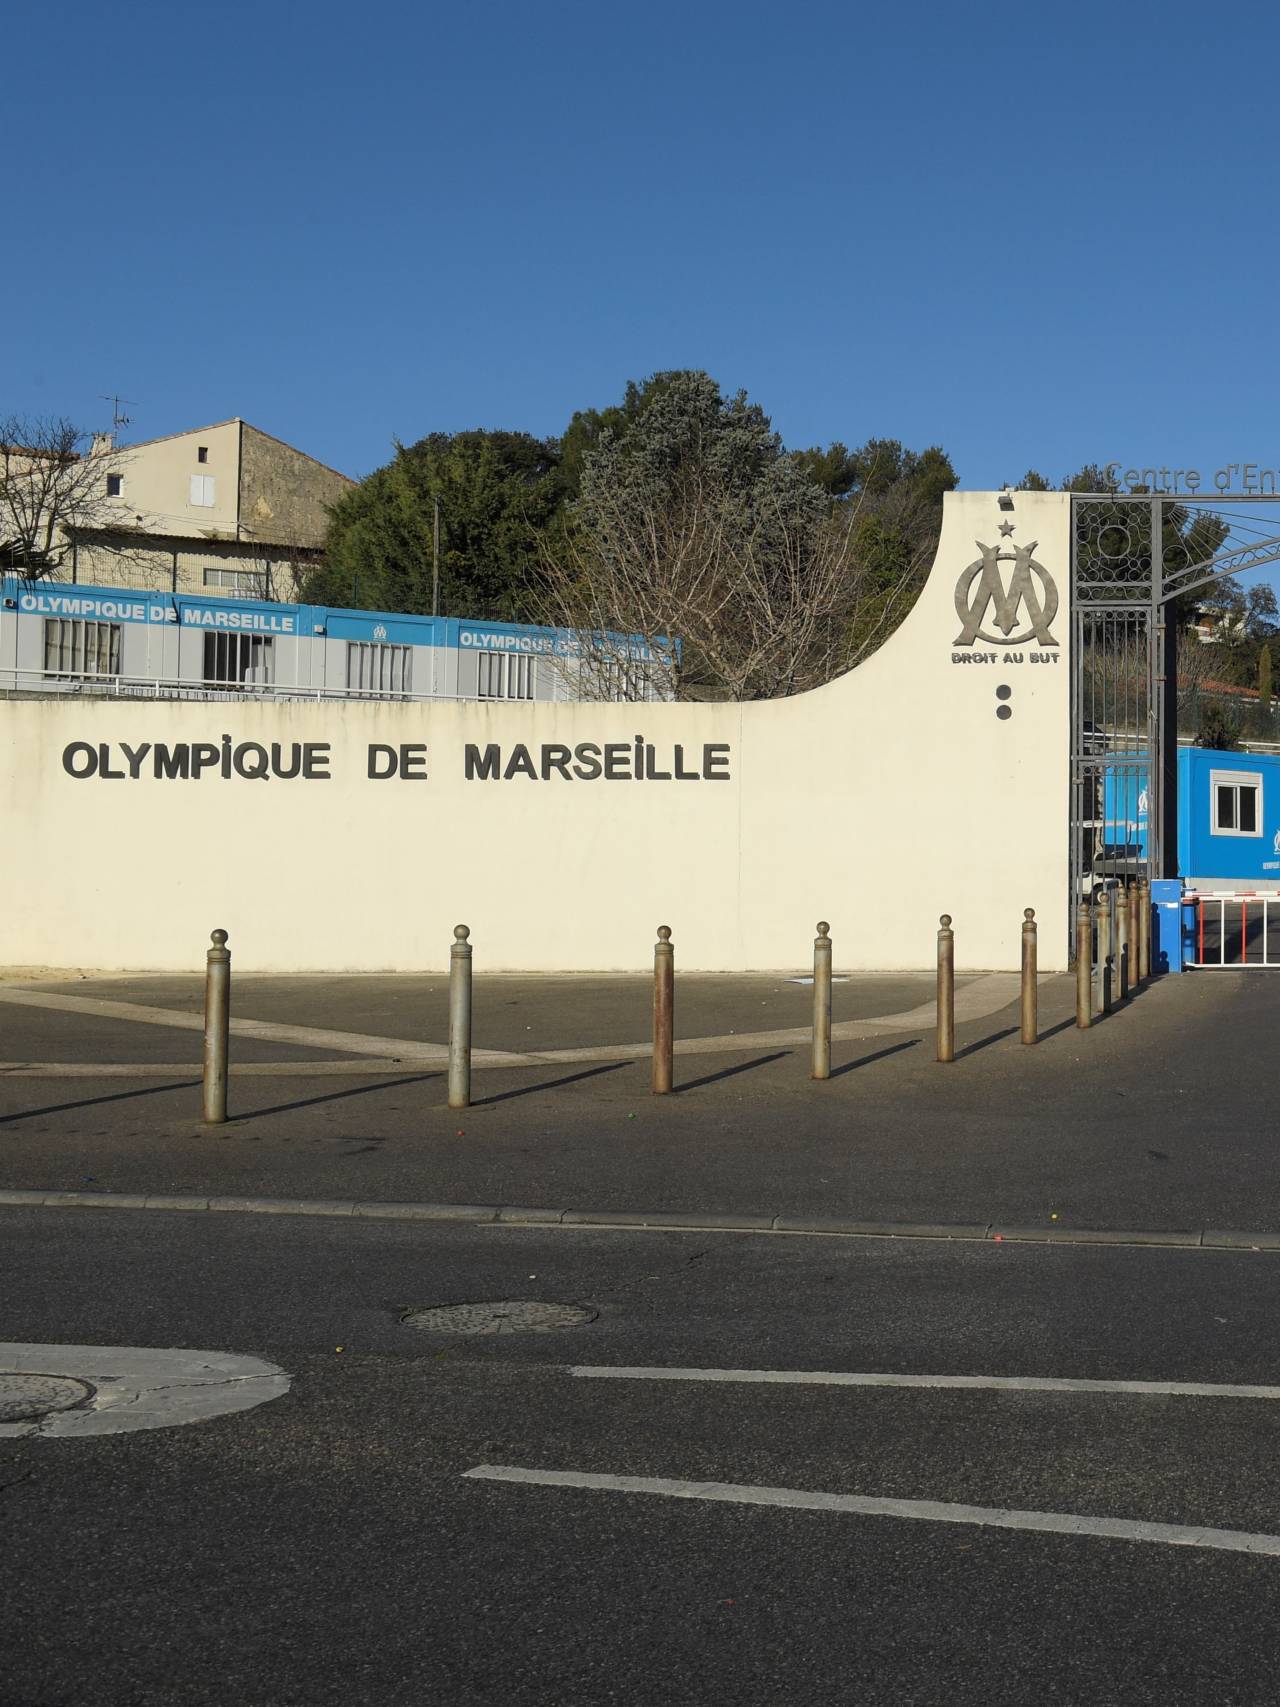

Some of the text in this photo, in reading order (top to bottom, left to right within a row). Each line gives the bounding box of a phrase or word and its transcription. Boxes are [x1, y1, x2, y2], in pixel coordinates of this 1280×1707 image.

[1103, 461, 1200, 488] Centre
[20, 594, 294, 632] OLYMPIQUE DE MARSEILLE
[951, 652, 1060, 664] DROIT AU BUT
[367, 742, 428, 780] DE
